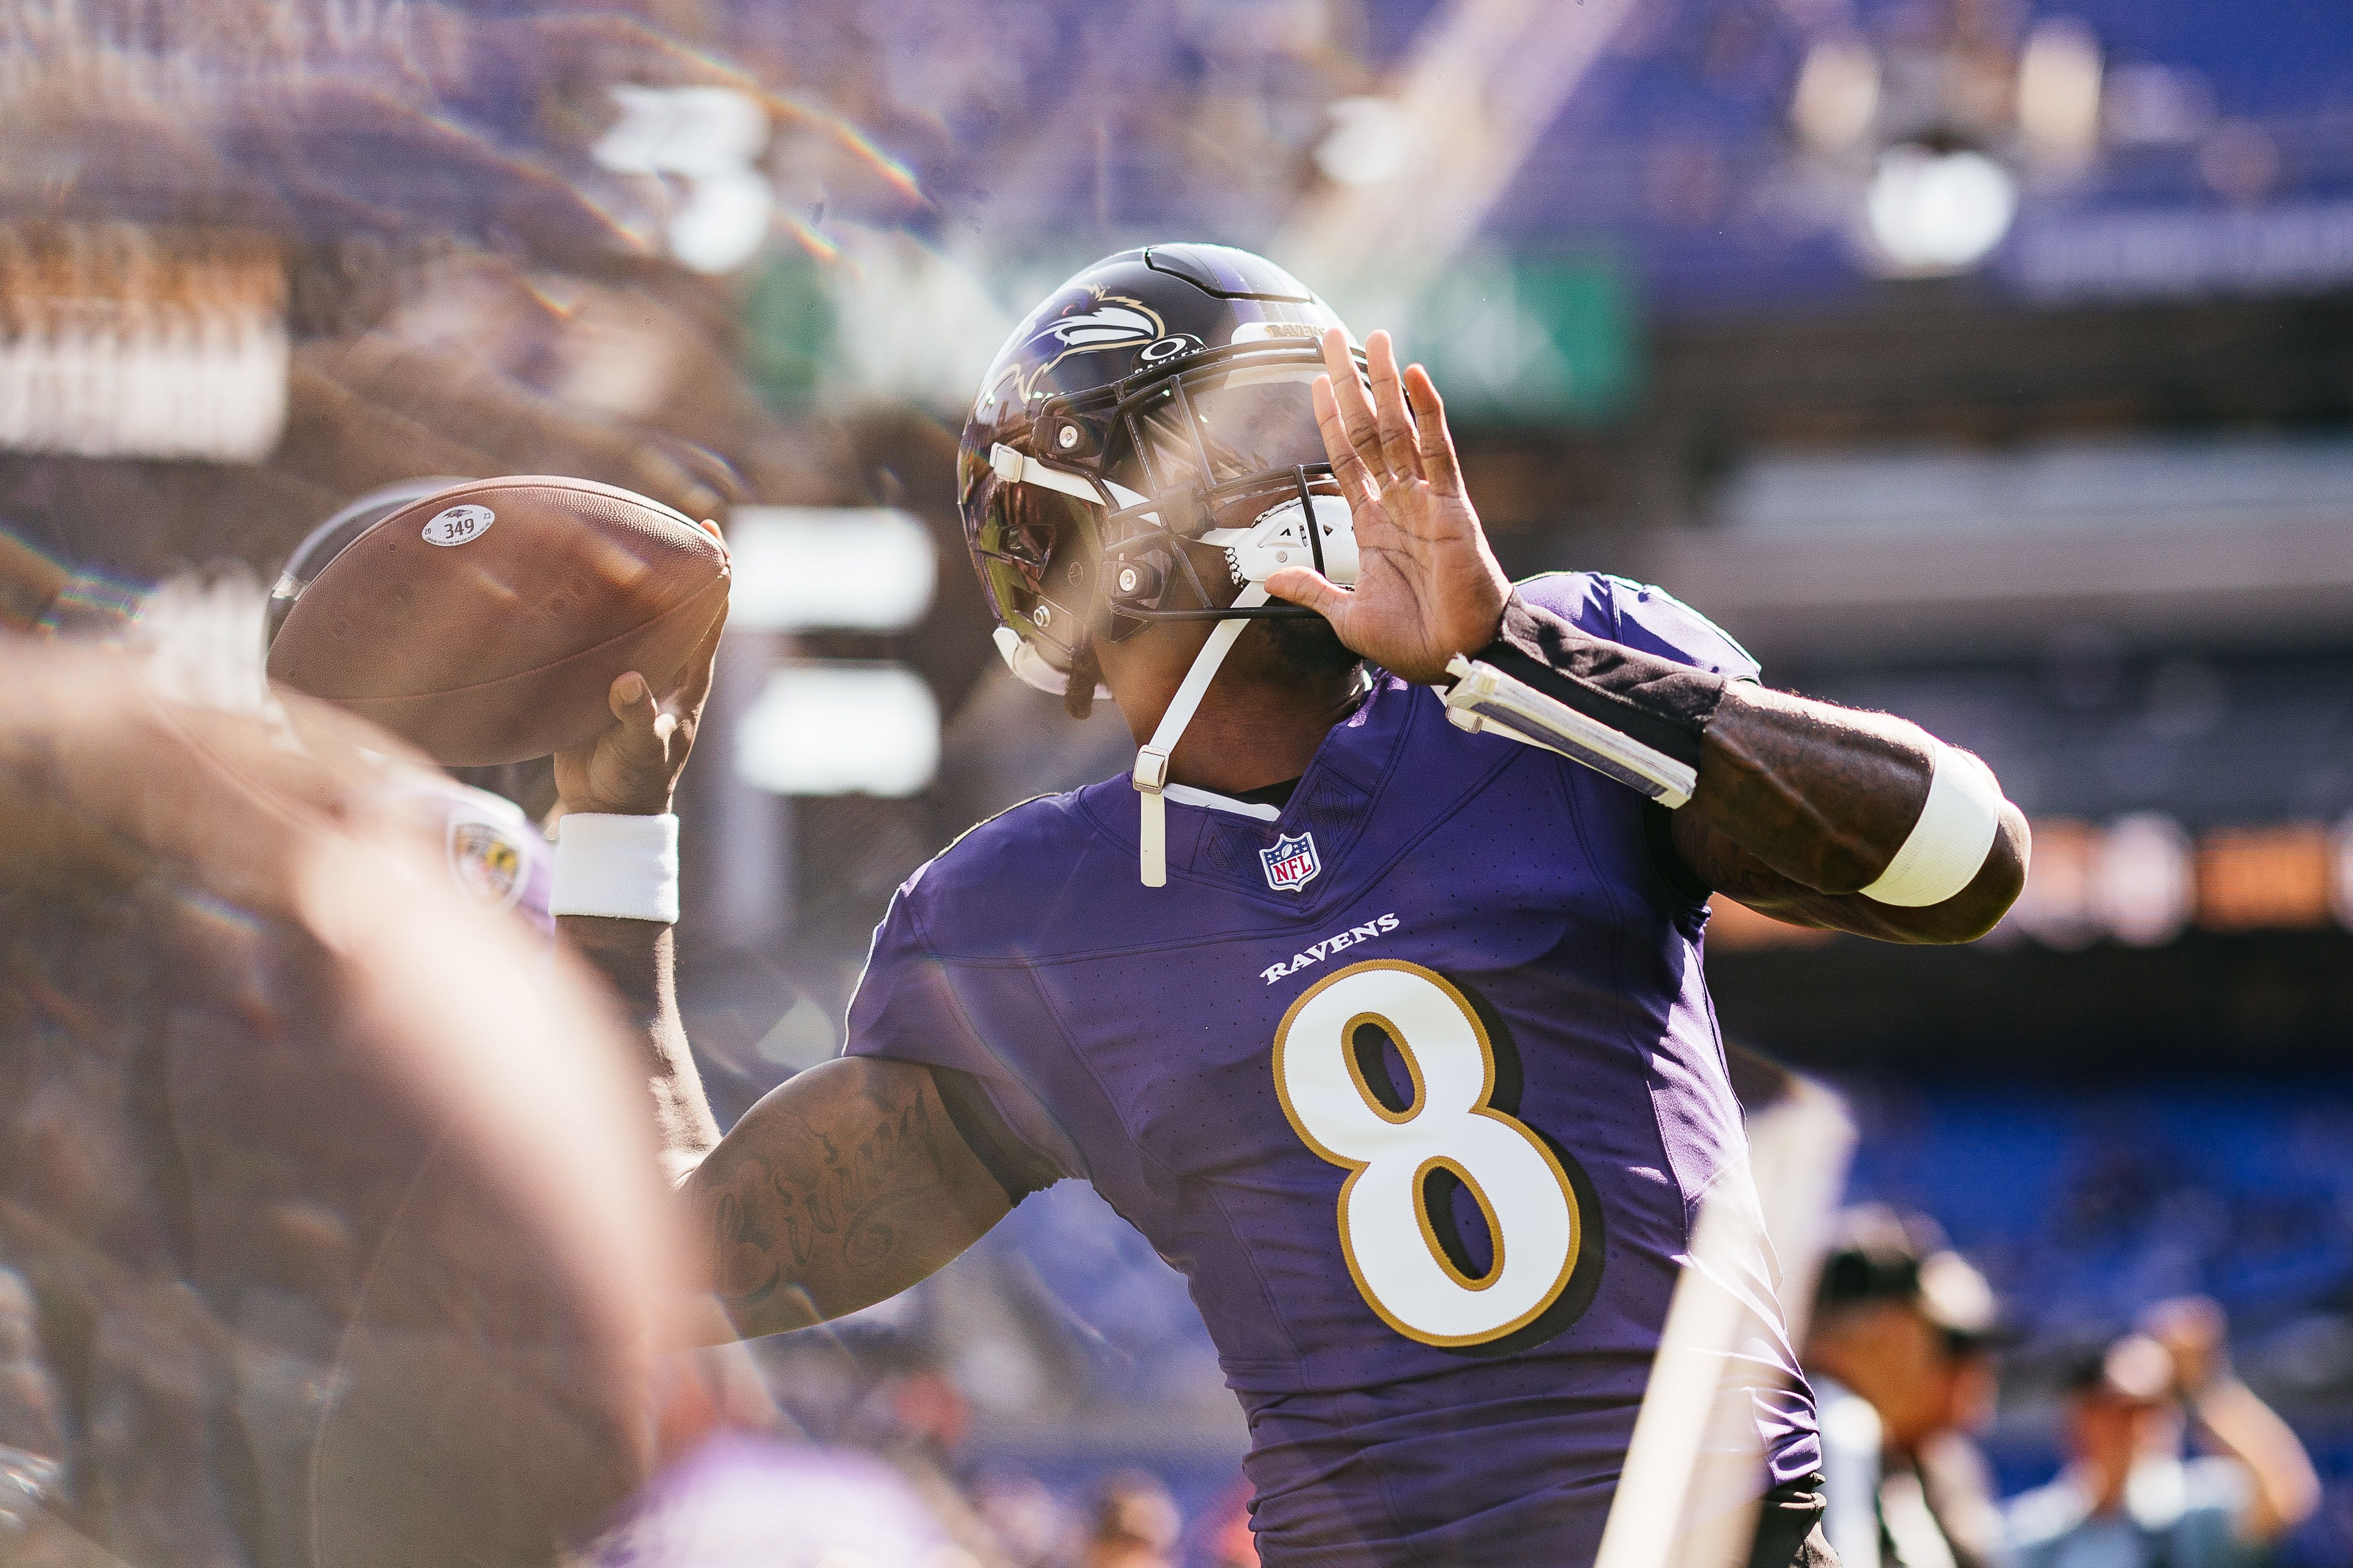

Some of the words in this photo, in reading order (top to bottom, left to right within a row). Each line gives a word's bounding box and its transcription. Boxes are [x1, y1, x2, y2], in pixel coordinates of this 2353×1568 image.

[444, 518, 474, 539] 349
[1273, 855, 1312, 882] NFL
[1259, 913, 1400, 986] RAVENS
[1272, 959, 1581, 1348] 8
